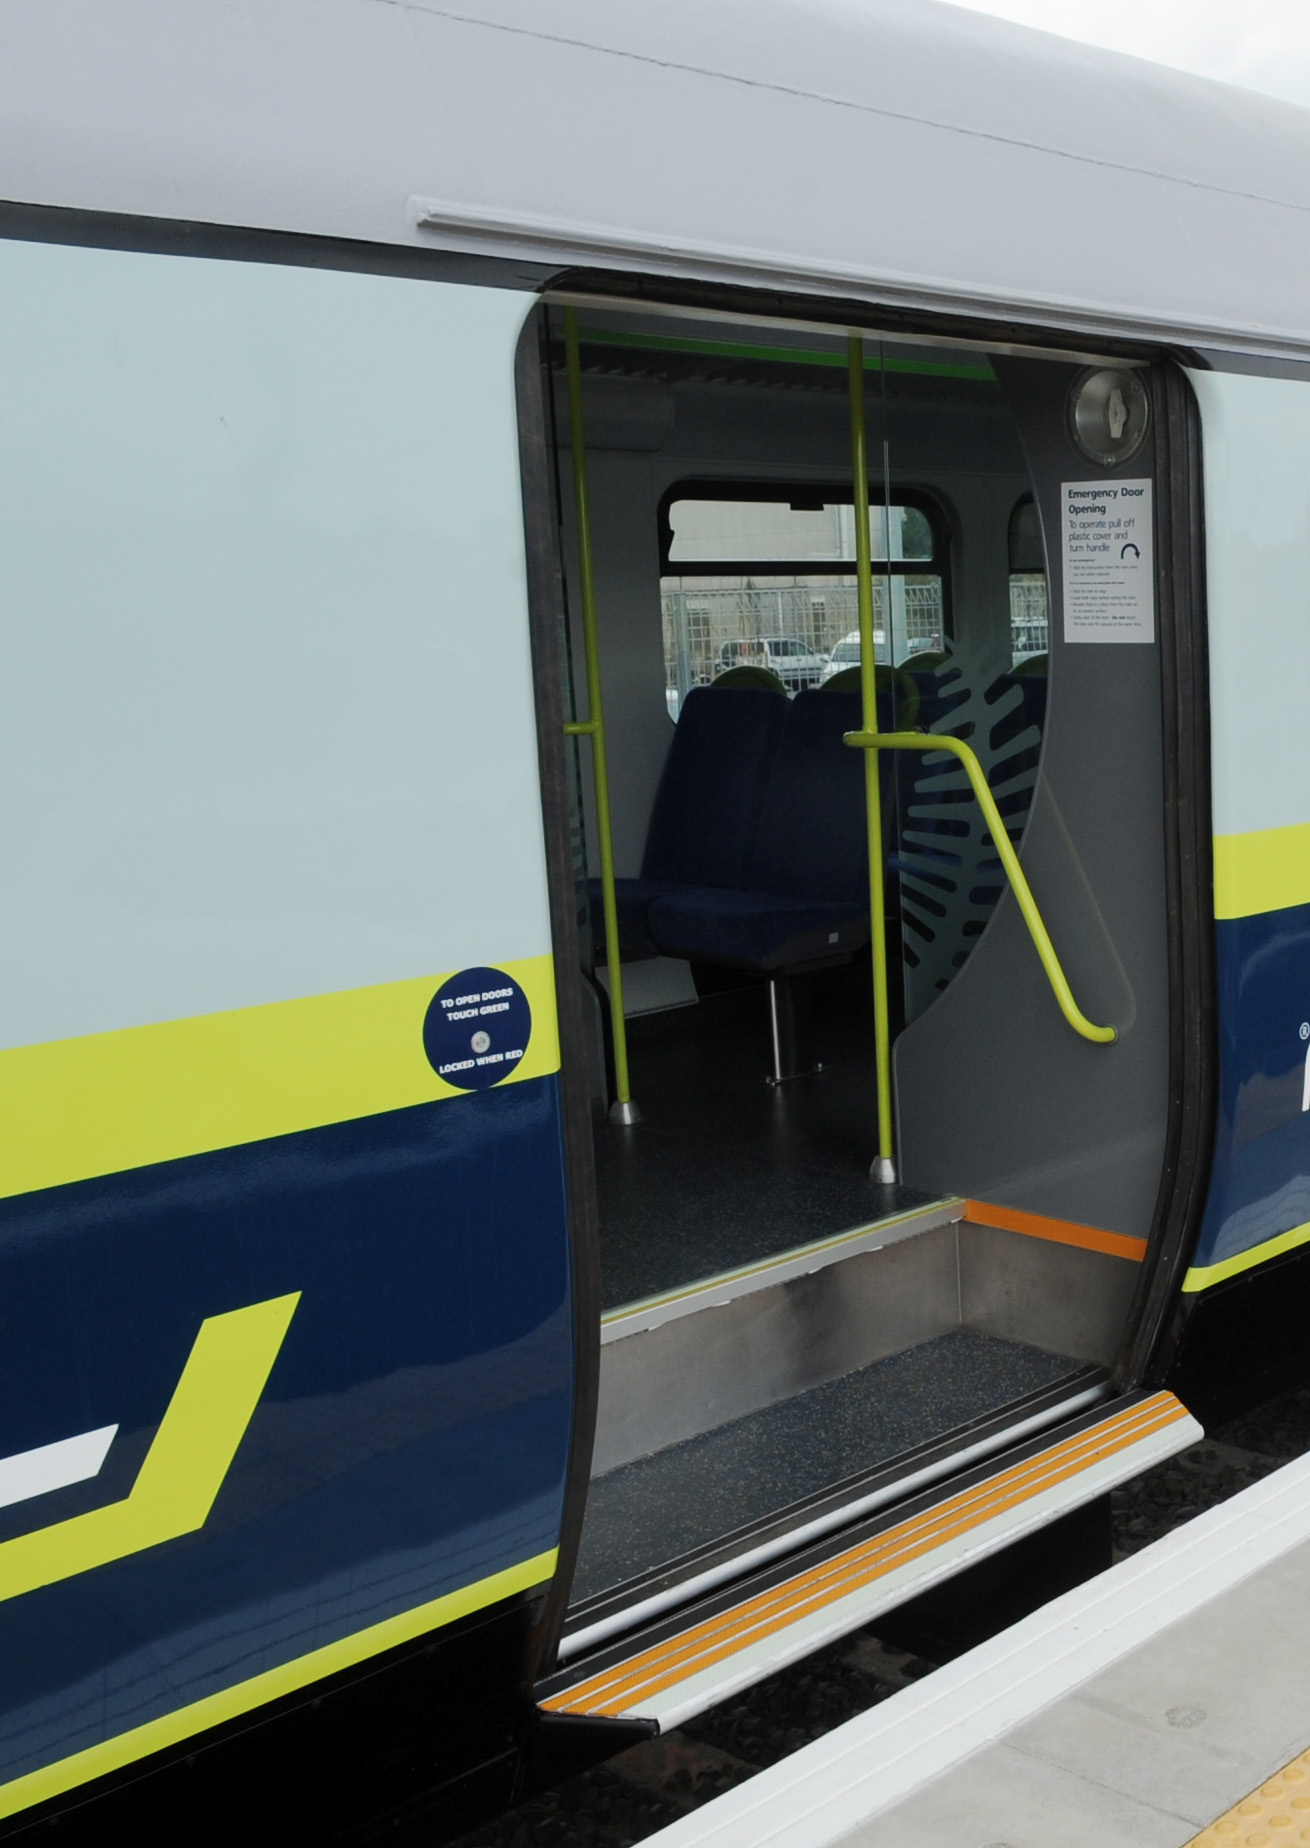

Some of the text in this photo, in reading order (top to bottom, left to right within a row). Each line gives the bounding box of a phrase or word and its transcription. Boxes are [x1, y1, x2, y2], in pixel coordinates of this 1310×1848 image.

[1068, 487, 1144, 500] Emergency Door
[1068, 503, 1106, 516] Opening
[1069, 518, 1136, 530] To operate pull off
[1068, 532, 1090, 542] plastic
[1114, 530, 1128, 540] and
[1086, 542, 1110, 552] handle
[440, 987, 513, 1008] TO OPEN DOORS
[446, 1002, 510, 1021] TOUCH GREEN
[439, 1049, 523, 1074] LOCKED WHEN RED
